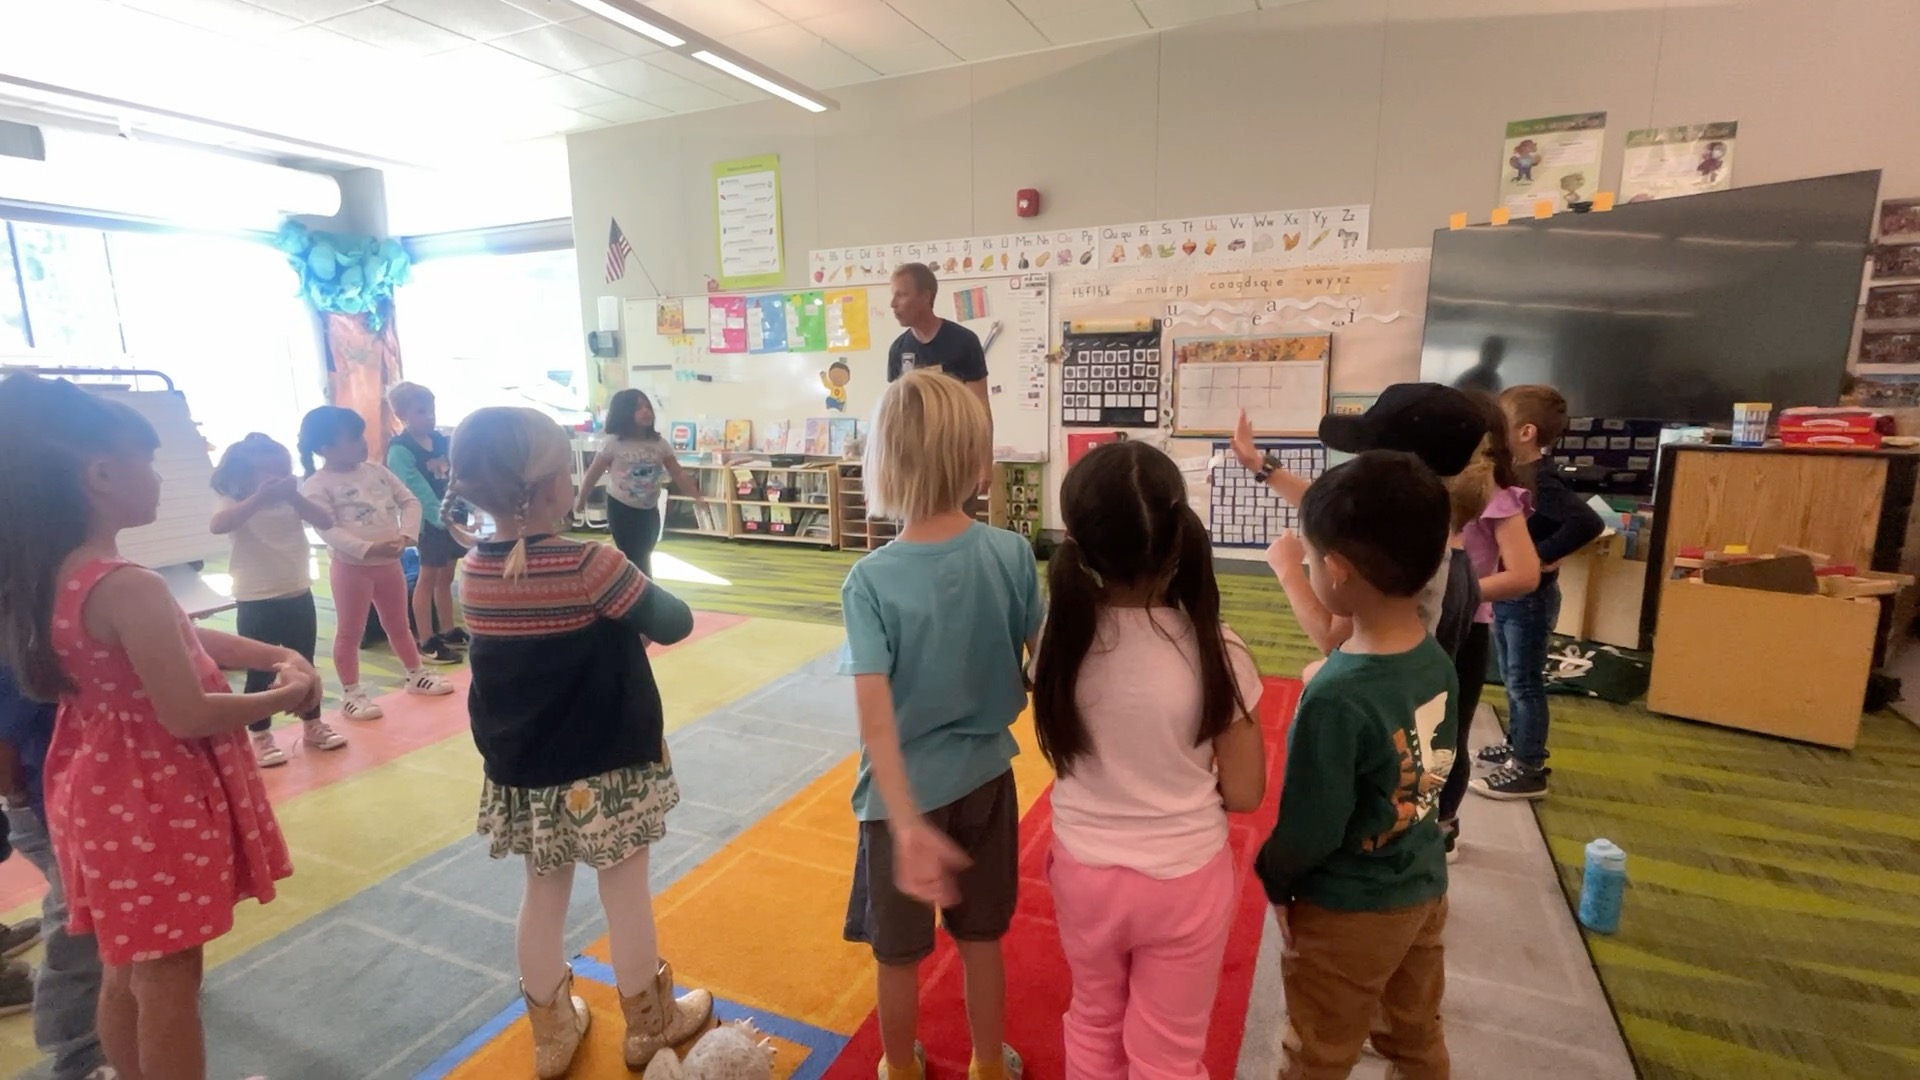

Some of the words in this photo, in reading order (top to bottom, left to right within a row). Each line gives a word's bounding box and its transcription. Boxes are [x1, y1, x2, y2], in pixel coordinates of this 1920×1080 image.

[908, 245, 921, 258] Gg
[963, 240, 972, 255] Jj
[982, 240, 994, 250] Kk
[1016, 236, 1032, 247] Mm
[1036, 235, 1050, 245] Nn
[1057, 233, 1072, 244] Oo
[1082, 230, 1093, 246] Pp
[1102, 228, 1118, 240] Qu
[1120, 230, 1132, 243] qu
[1140, 226, 1150, 237] Rr
[1162, 223, 1172, 234] Ss
[1182, 221, 1194, 233] Tt
[1204, 220, 1217, 232] Uu
[1230, 218, 1244, 230] Vv
[1254, 216, 1274, 227] Ww
[1284, 213, 1299, 226] Xx
[1312, 211, 1328, 228] Yy
[1342, 209, 1356, 222] Zz
[1167, 305, 1178, 316] u
[1266, 300, 1277, 313] a
[1163, 317, 1173, 328] o
[1252, 314, 1262, 327] e
